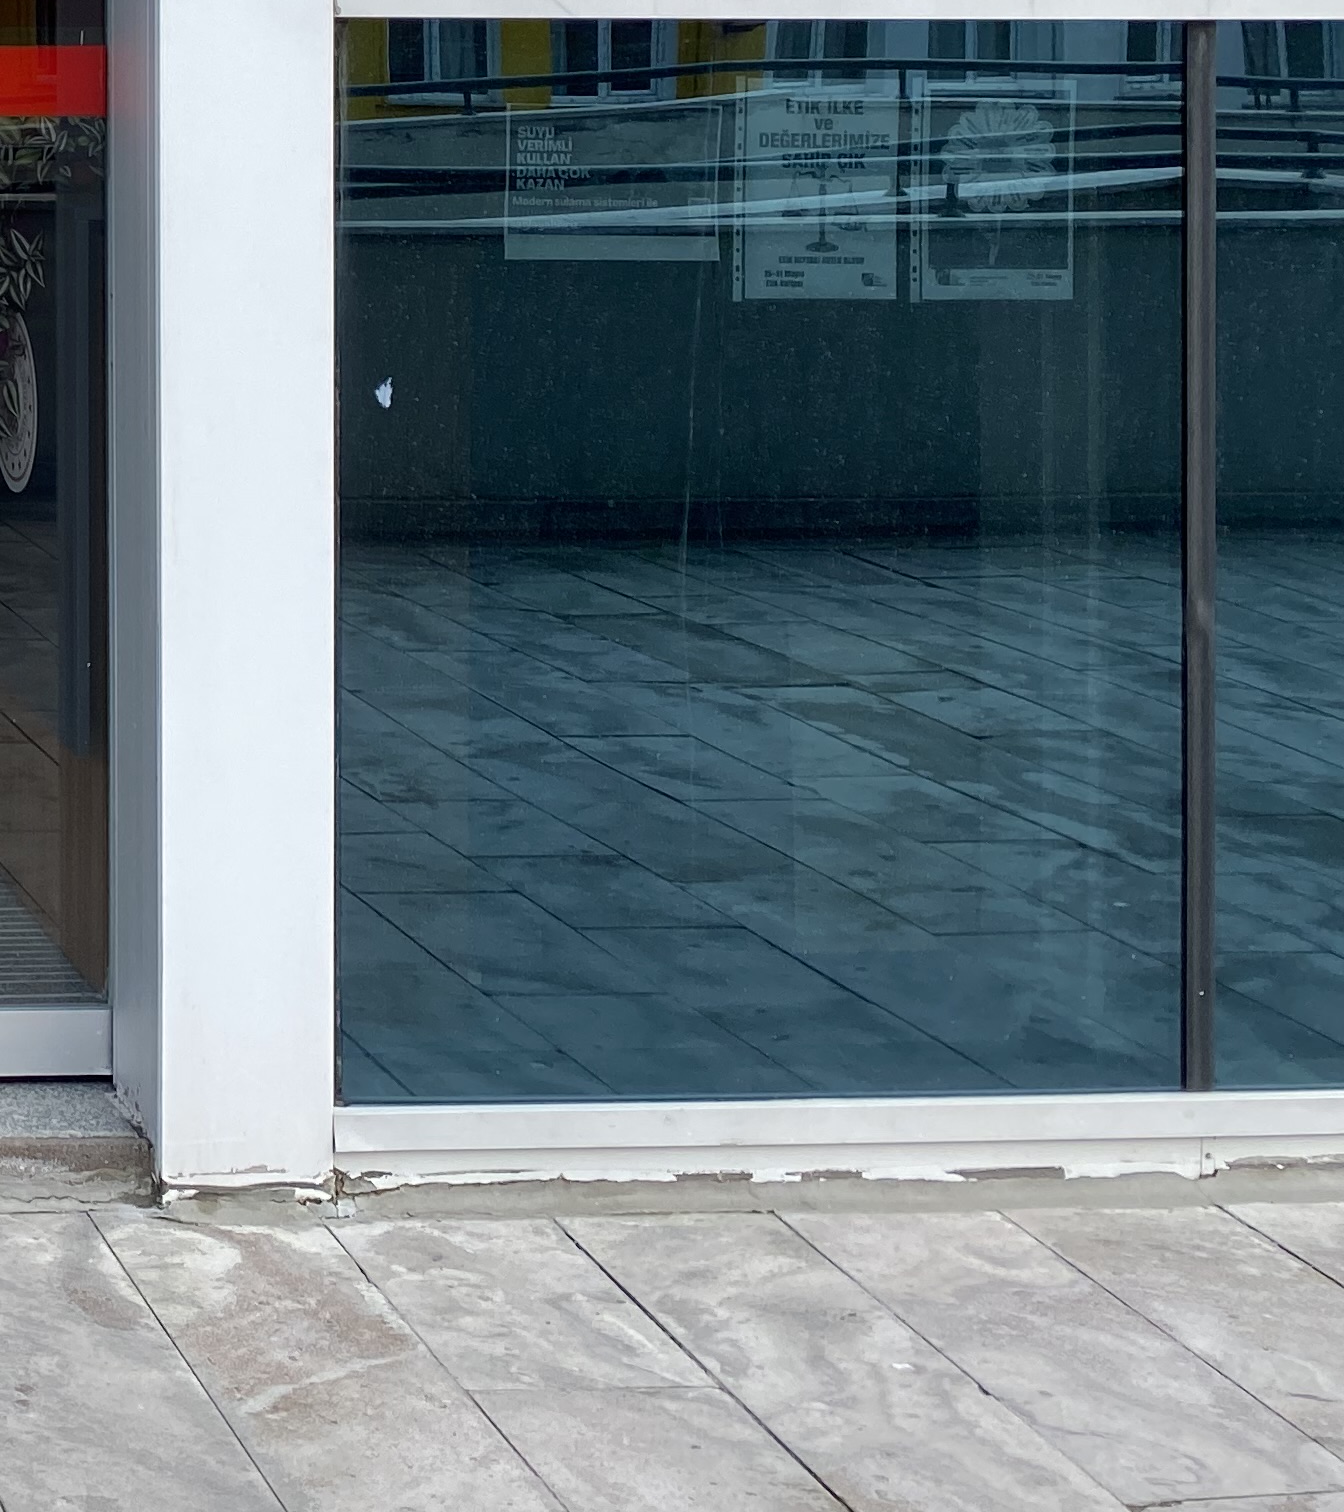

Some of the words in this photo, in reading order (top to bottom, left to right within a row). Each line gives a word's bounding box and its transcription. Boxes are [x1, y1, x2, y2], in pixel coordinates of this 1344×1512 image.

[814, 118, 833, 130] ve
[518, 126, 555, 138] SUYU
[518, 136, 573, 151] VERİMLİ
[759, 129, 890, 149] DEĞERLERİMİZE
[517, 153, 571, 164] KULLAN
[517, 179, 564, 190] KAZAN
[513, 196, 553, 206] Modern
